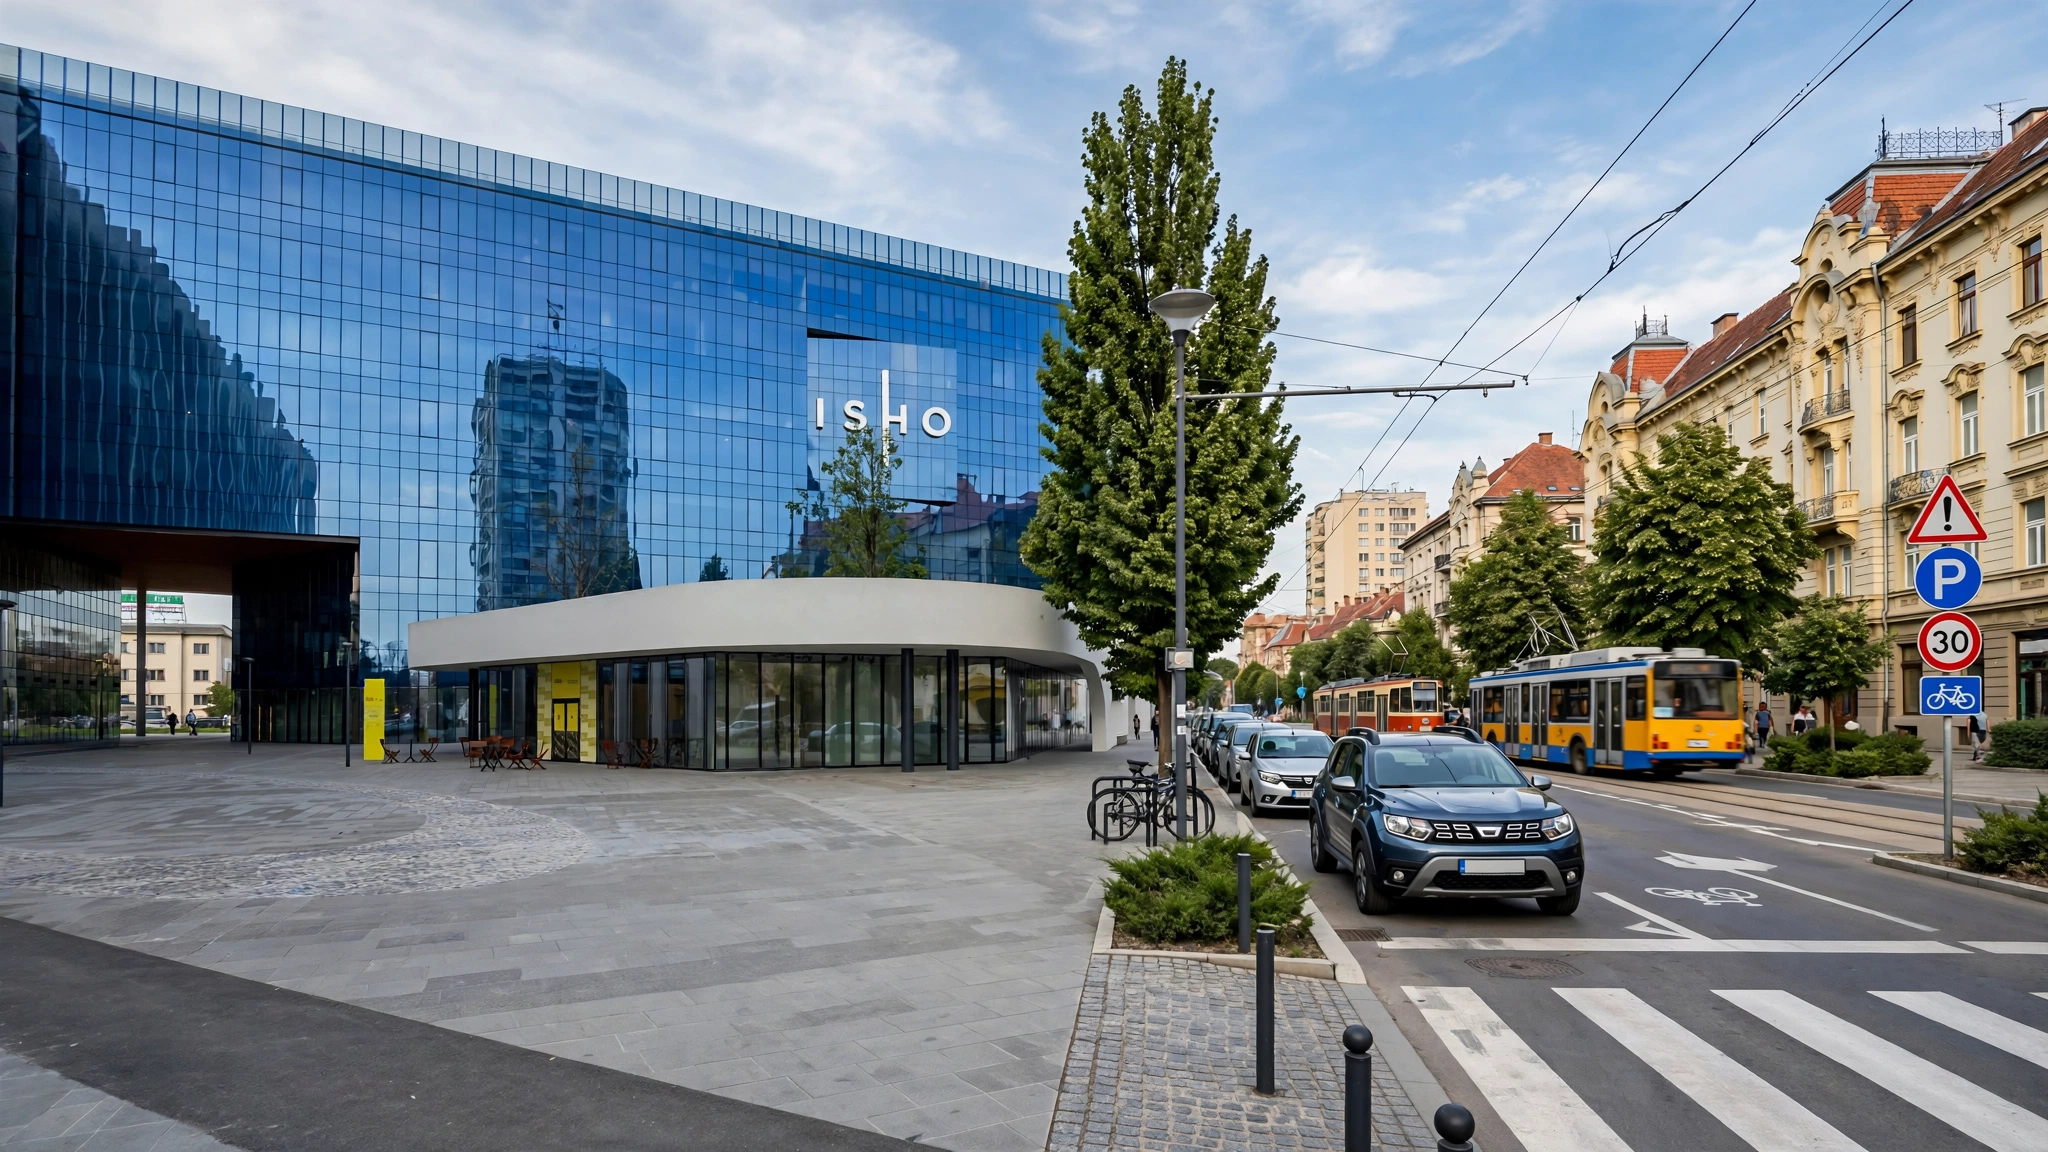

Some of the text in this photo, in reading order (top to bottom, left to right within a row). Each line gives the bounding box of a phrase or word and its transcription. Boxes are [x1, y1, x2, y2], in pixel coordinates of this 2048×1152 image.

[816, 369, 952, 467] ISHO
[1934, 558, 1966, 600] P
[1932, 630, 1969, 654] 30
